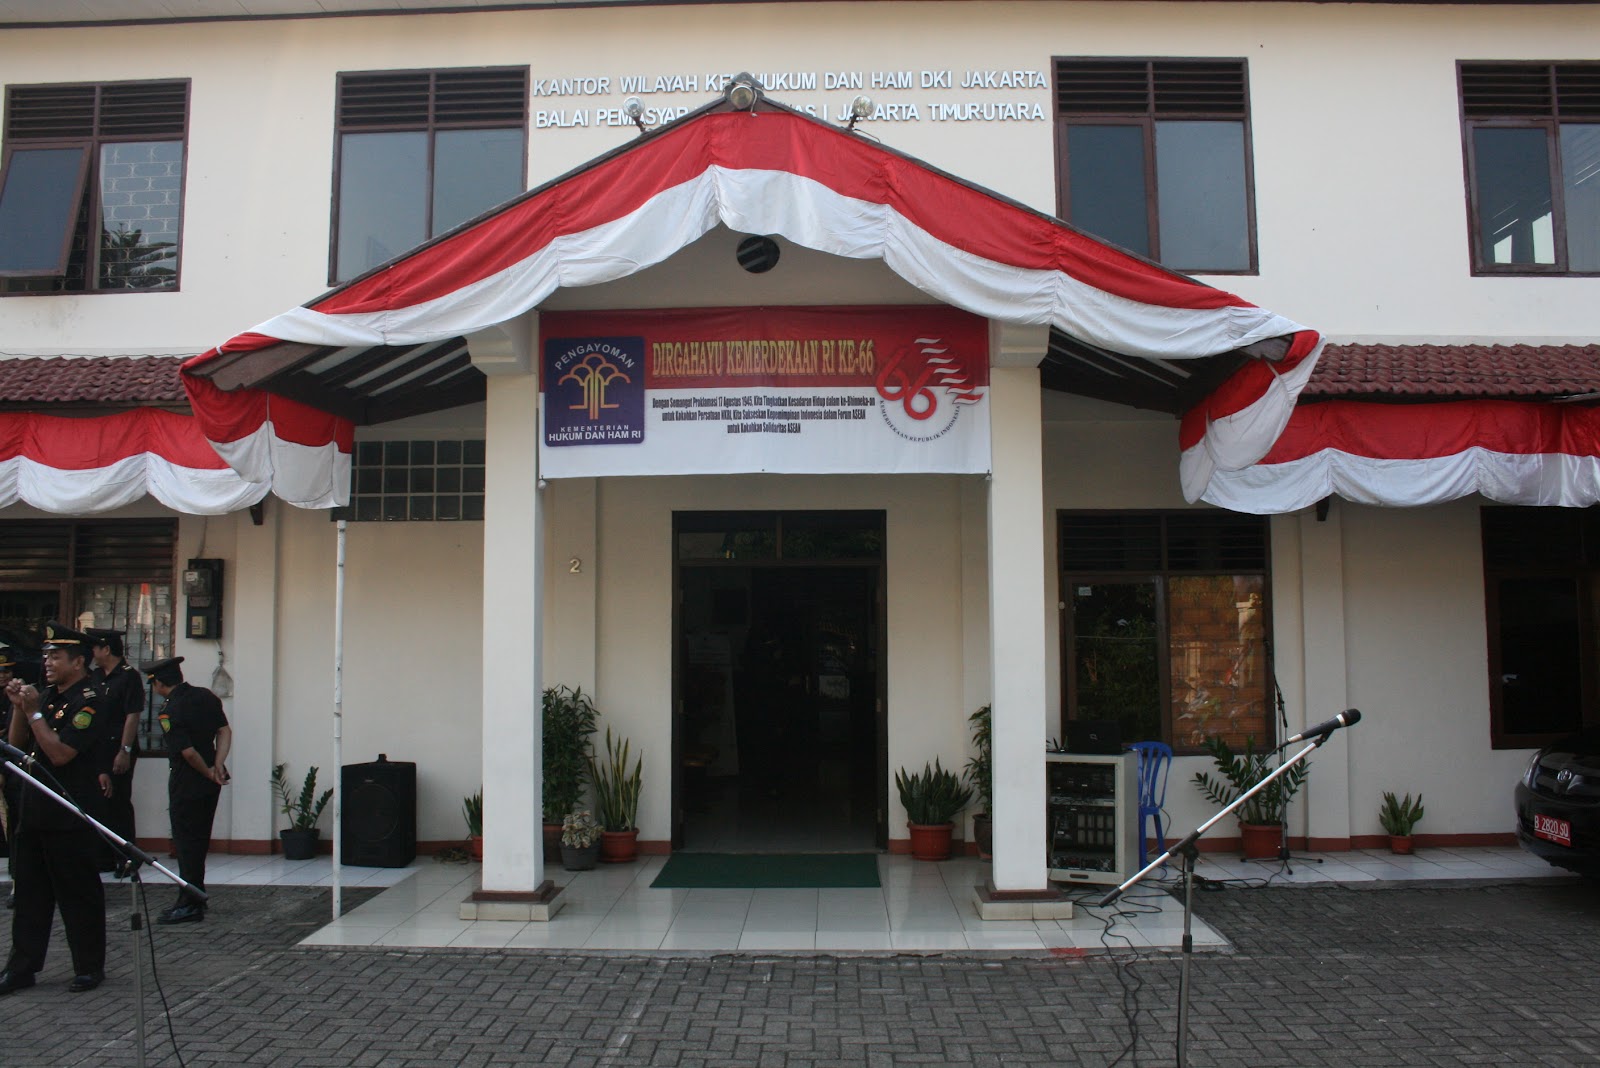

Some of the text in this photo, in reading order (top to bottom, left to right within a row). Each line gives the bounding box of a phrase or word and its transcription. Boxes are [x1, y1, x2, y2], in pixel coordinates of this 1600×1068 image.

[533, 76, 611, 96] KANTOR
[620, 75, 698, 94] WILAYAH
[824, 72, 863, 90] DAN
[871, 71, 913, 89] HAM
[920, 71, 952, 88] DKI
[961, 70, 1048, 89] JAKARTA
[536, 109, 589, 128] BALAI
[554, 343, 635, 370] PENGAYOMAN
[652, 339, 874, 376] DIRGAHAYU KEMERDEKAAN RI KE-66
[560, 424, 629, 433] KEMENTERIAN
[880, 400, 961, 442] KEMERDEKAAN REPUBLIK INDONESIA
[548, 430, 641, 441] HUKUM DAN HAM RI
[570, 558, 580, 573] 2
